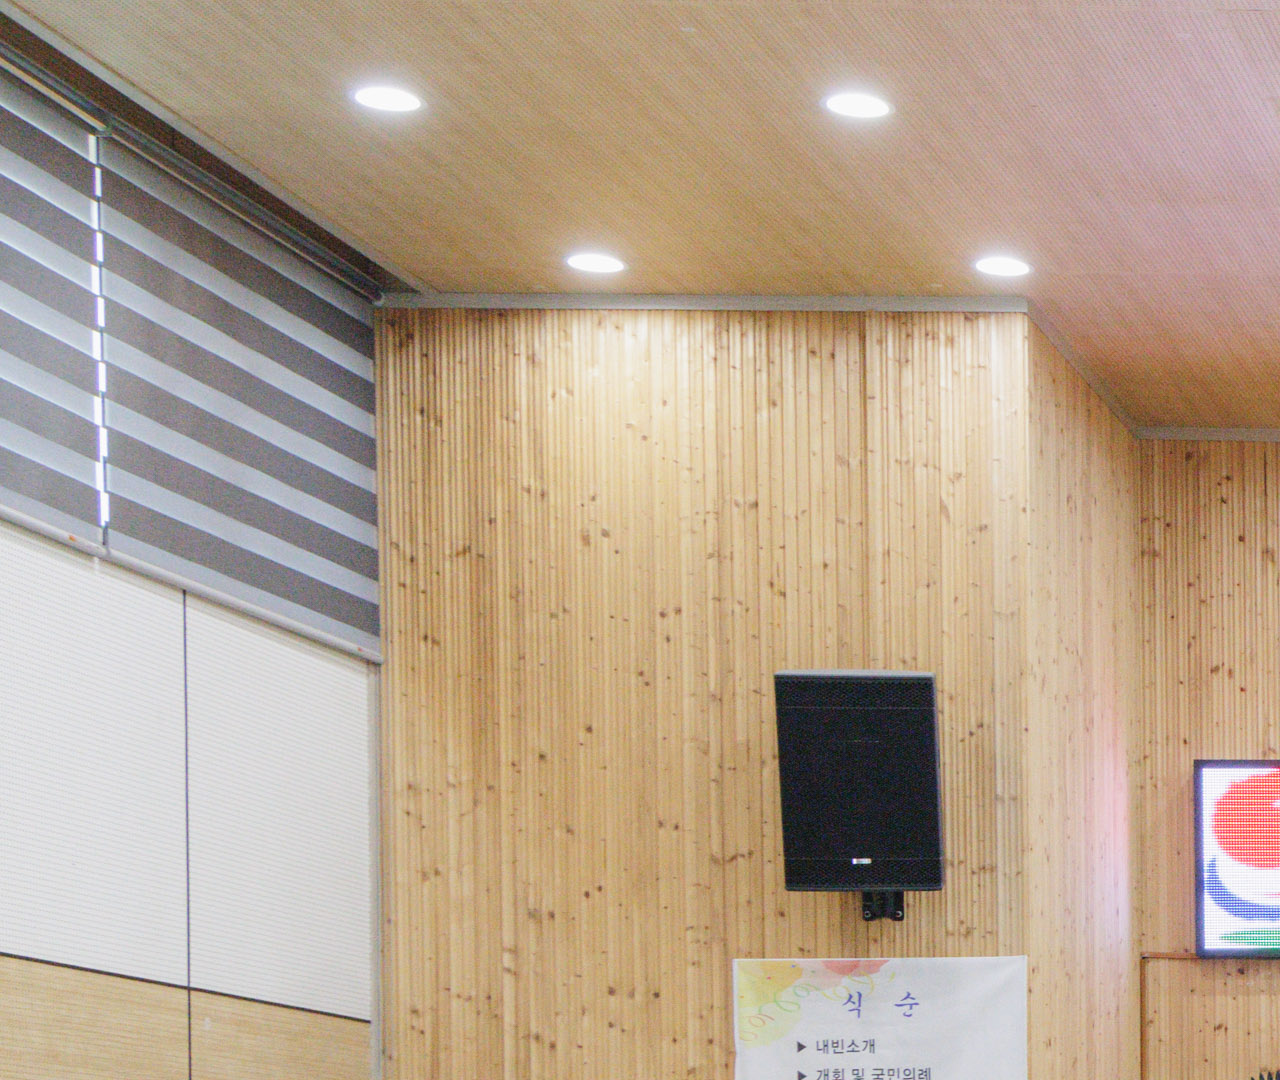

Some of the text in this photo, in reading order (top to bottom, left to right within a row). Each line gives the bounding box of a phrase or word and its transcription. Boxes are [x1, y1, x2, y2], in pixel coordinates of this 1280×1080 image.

[843, 991, 920, 1019] 식 순
[816, 1038, 876, 1055] 내빈소개
